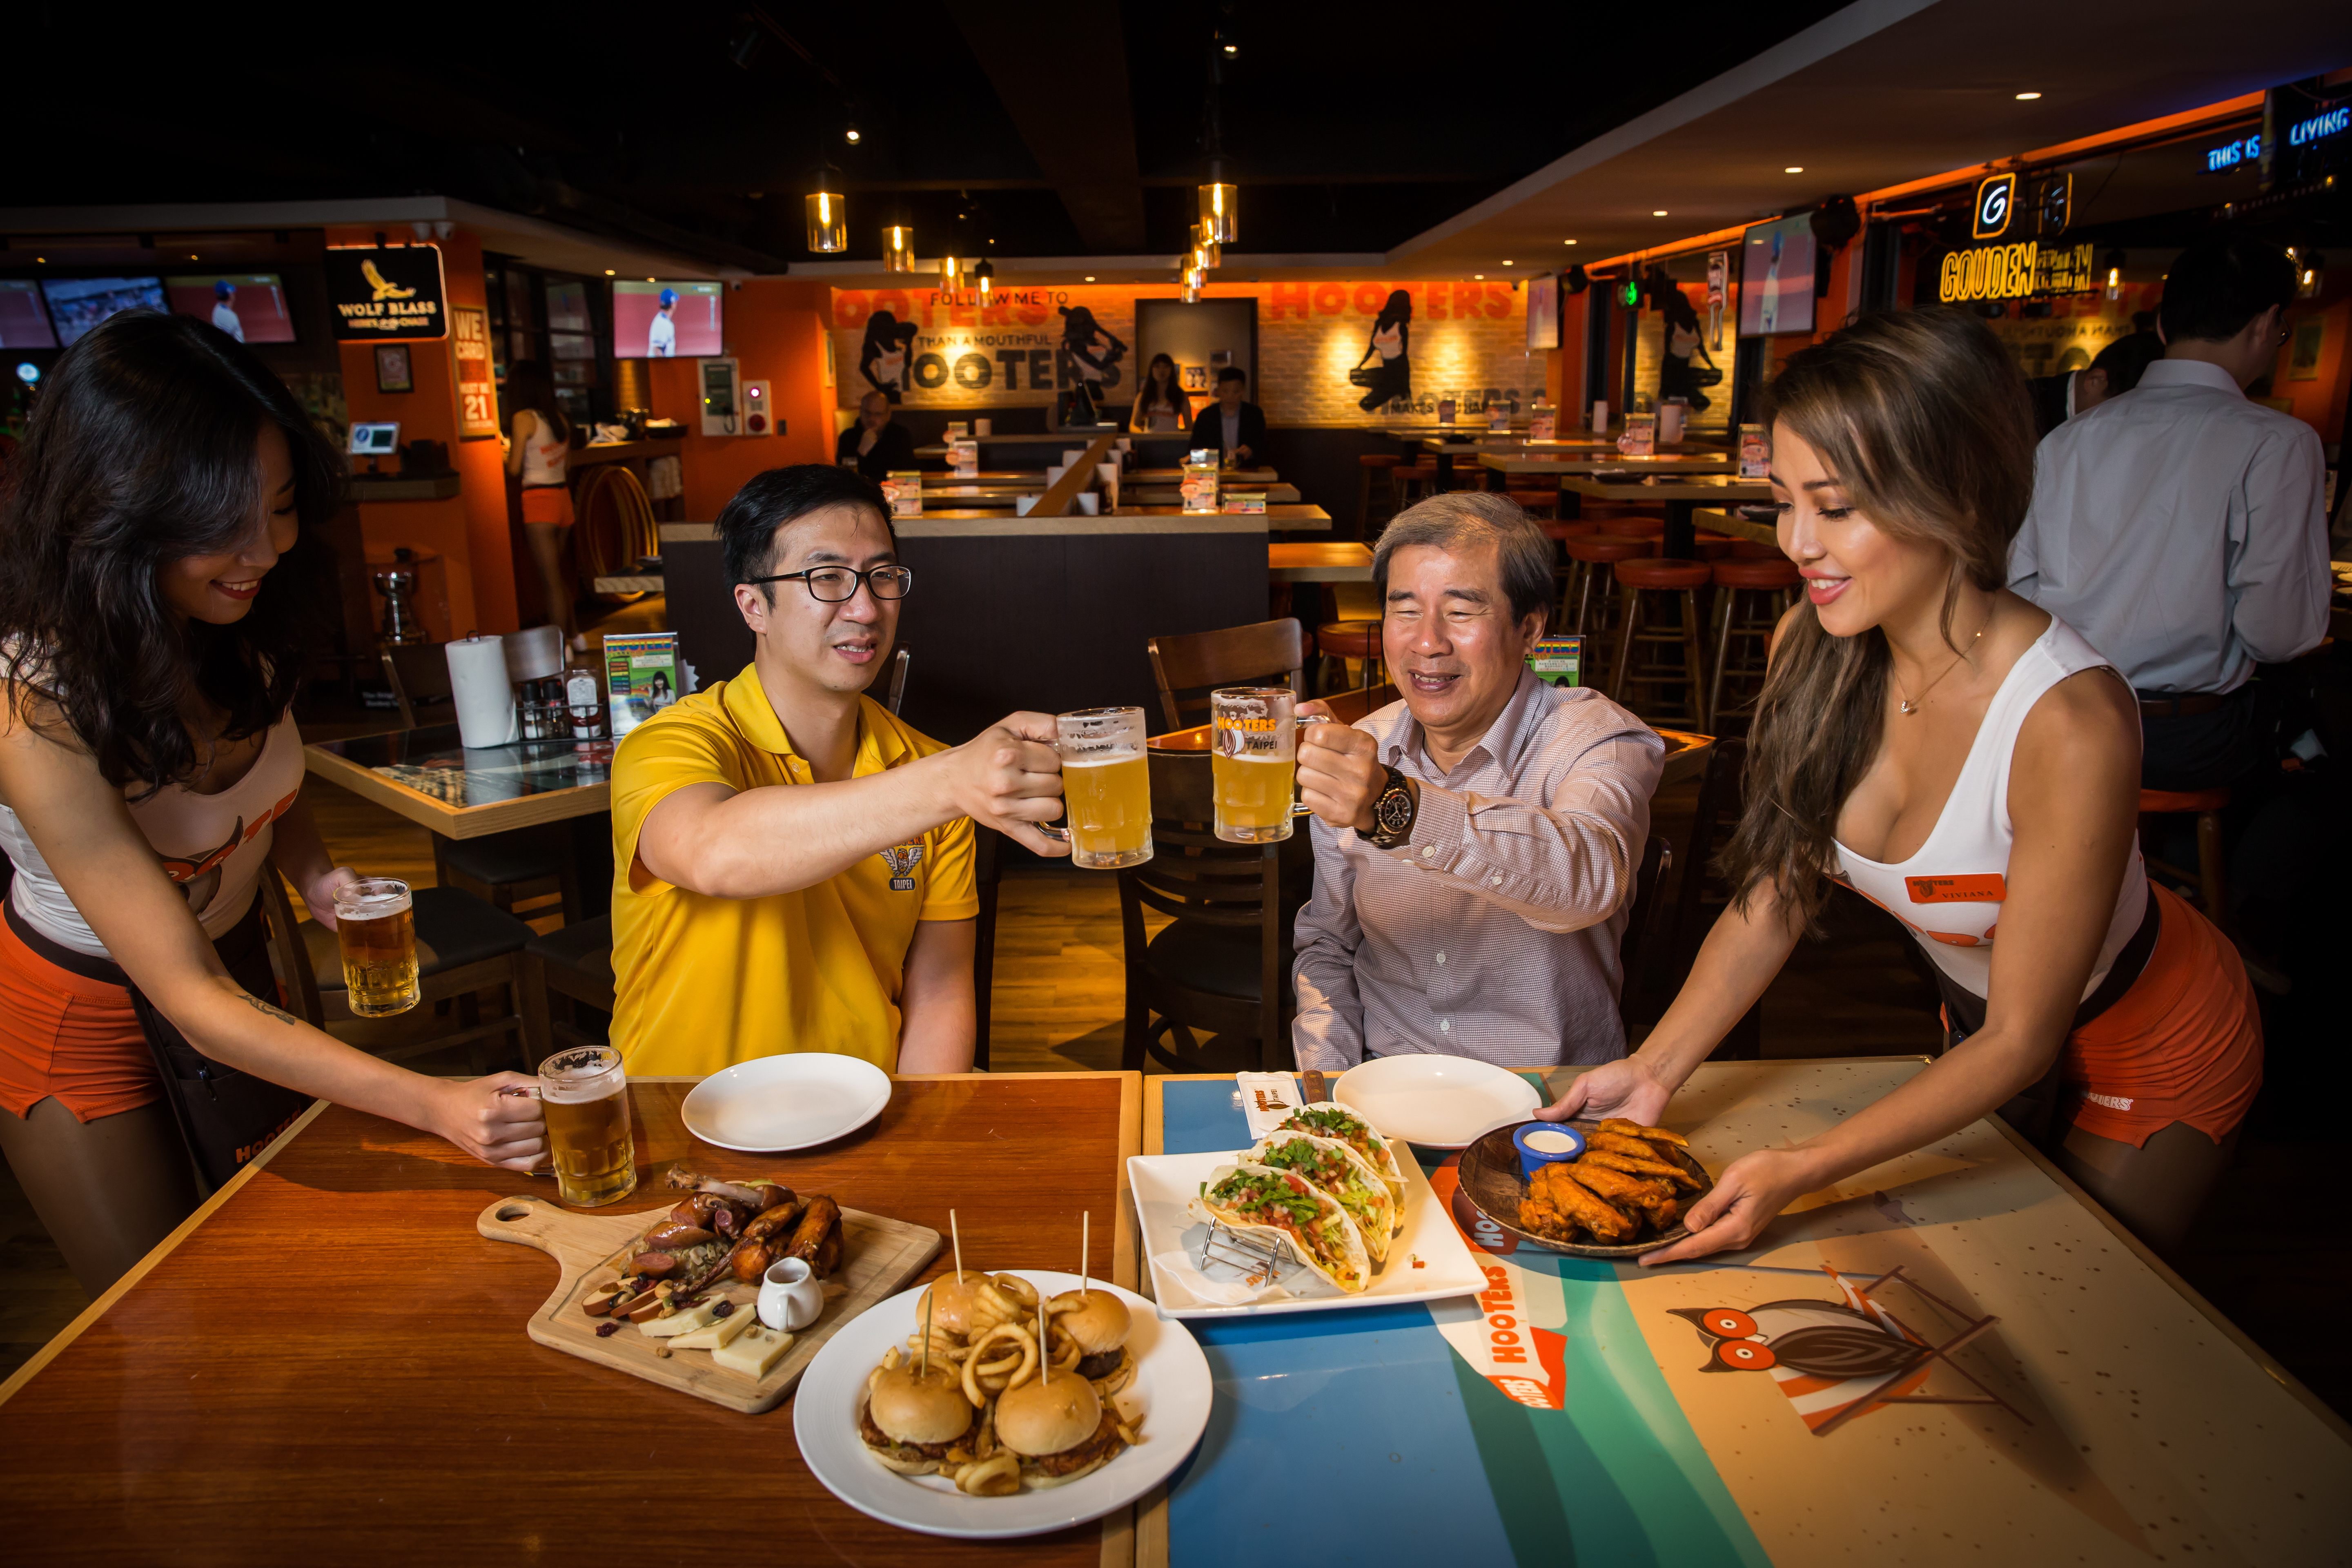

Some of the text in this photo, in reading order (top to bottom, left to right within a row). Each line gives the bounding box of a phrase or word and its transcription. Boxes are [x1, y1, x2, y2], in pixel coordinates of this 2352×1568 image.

[2290, 107, 2350, 145] LIVING
[2207, 134, 2261, 172] THIS IS
[1982, 185, 2008, 224] G
[1940, 241, 2038, 302] GOUDEN
[930, 290, 1069, 307] FOLLW ME TO
[1270, 282, 1513, 320] HOOTERS
[337, 301, 437, 317] WOLF BLASS
[454, 311, 483, 341] WE
[917, 334, 1052, 347] THAN A MOUTHFUL
[463, 394, 488, 420] 21
[1217, 716, 1276, 732] HOOTERS
[1245, 741, 1277, 750] TAIPEI
[893, 879, 912, 890] TAIPEI
[1941, 890, 1994, 898] VIVIANA
[1254, 1090, 1270, 1112] HOOTERS
[1270, 1089, 1279, 1105] TAIPEI
